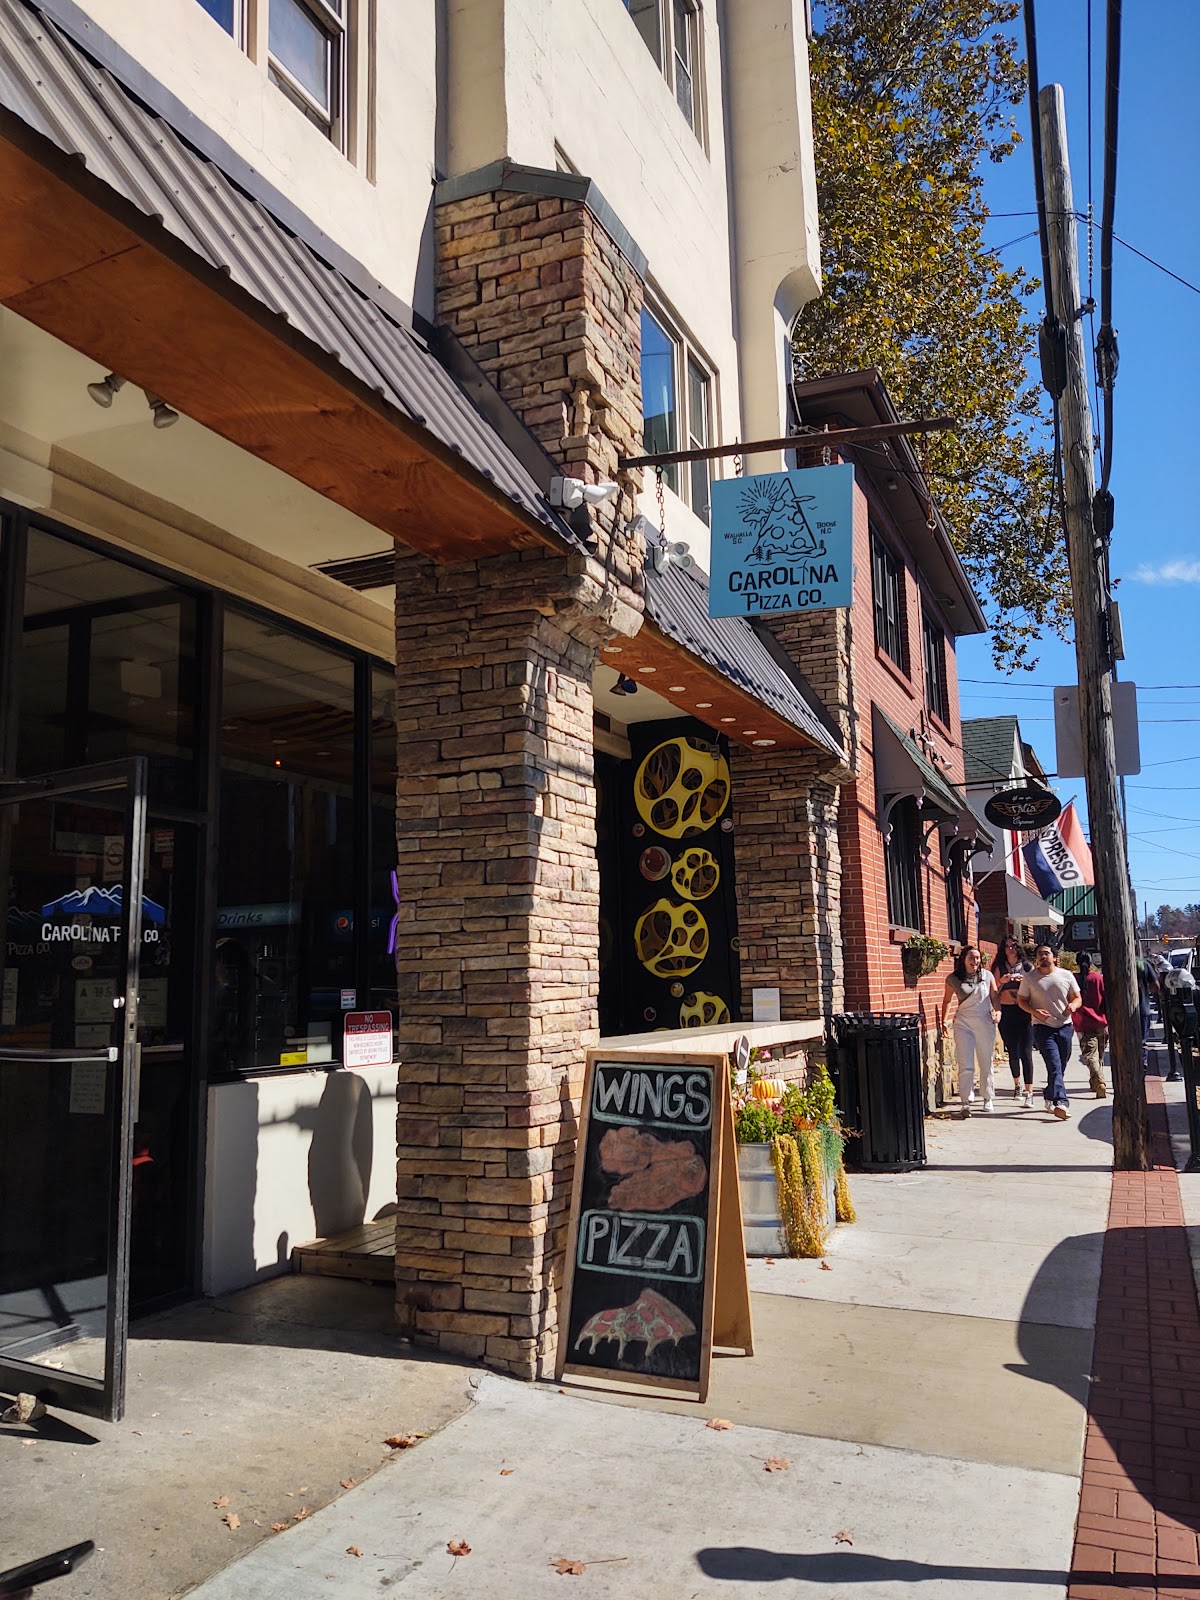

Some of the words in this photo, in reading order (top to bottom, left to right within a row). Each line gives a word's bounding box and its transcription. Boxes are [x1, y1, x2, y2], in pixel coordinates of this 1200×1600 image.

[815, 521, 836, 529] BOONE
[723, 531, 752, 540] WALHALLA
[728, 562, 839, 593] CAROLINA
[740, 592, 792, 611] PIZZA
[797, 589, 826, 607] CO.
[216, 912, 263, 925] Drinks
[41, 922, 110, 943] CAROLINA
[144, 929, 161, 943] CO.
[80, 988, 87, 997] A
[348, 1023, 389, 1033] TRESPASSING
[598, 1069, 710, 1123] WINGS
[587, 1217, 694, 1275] PIZZA
